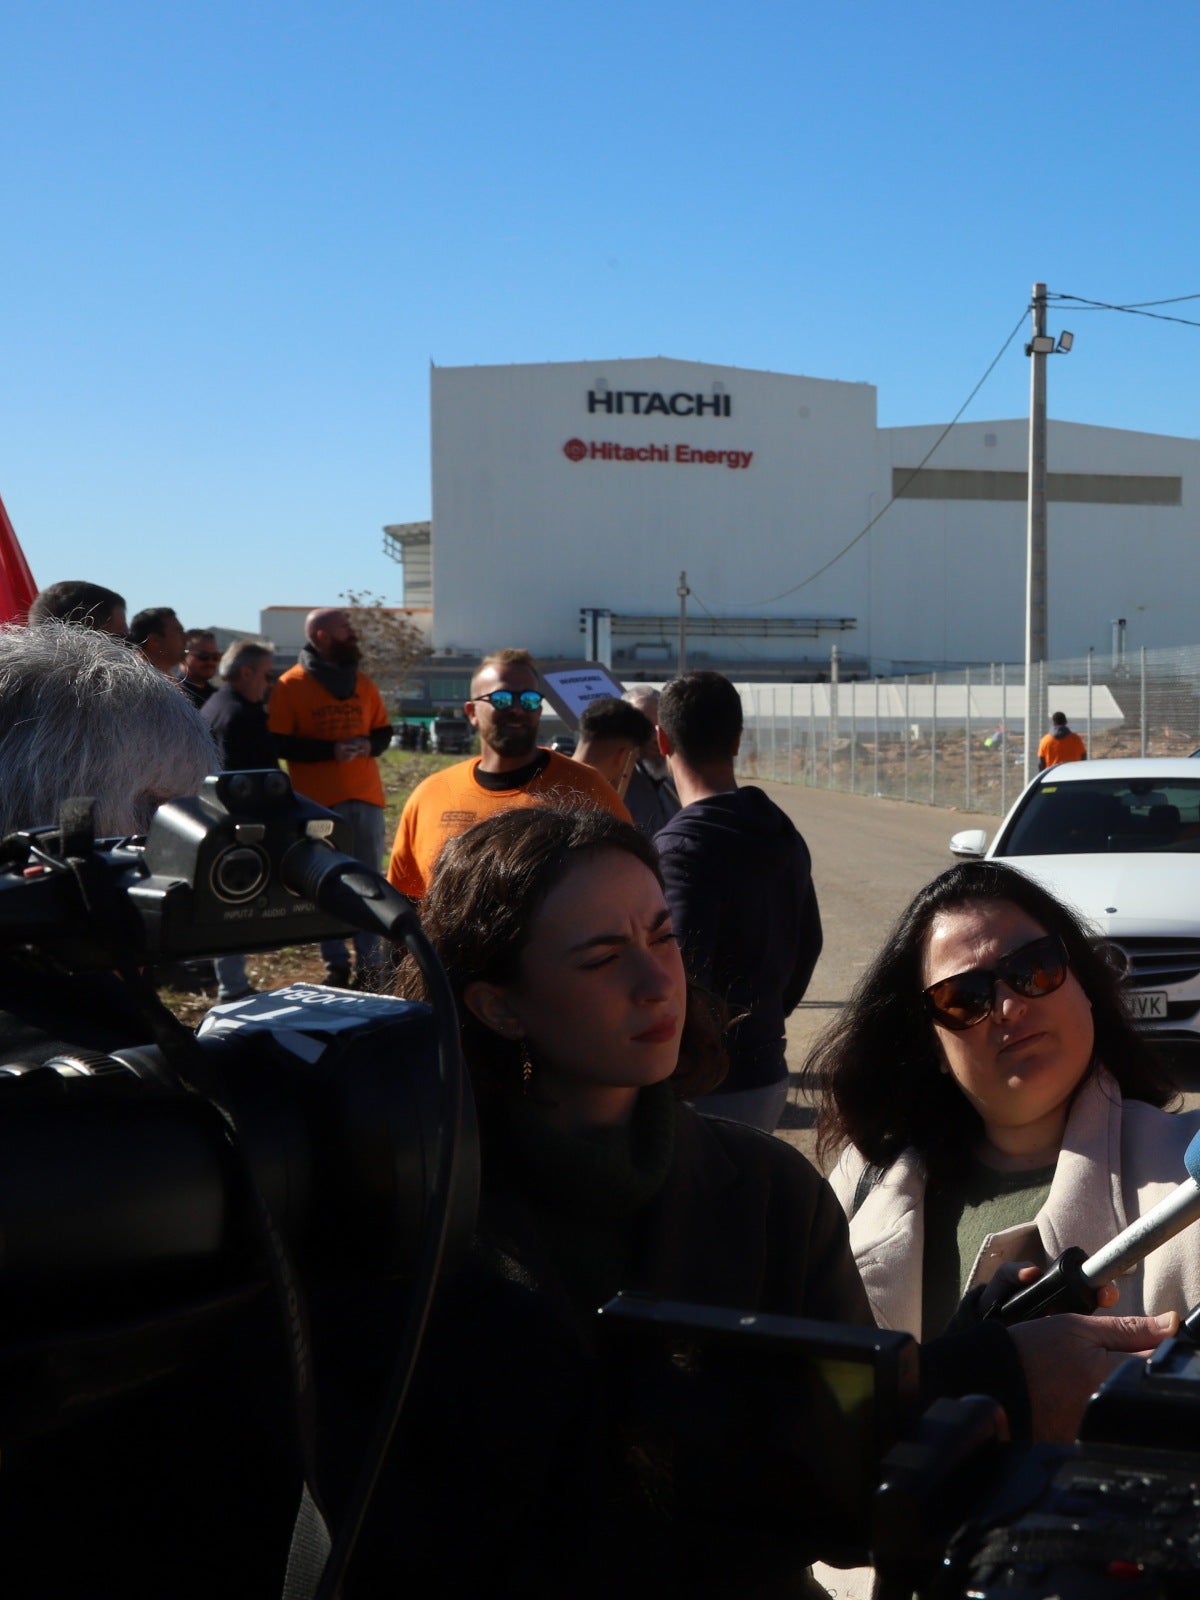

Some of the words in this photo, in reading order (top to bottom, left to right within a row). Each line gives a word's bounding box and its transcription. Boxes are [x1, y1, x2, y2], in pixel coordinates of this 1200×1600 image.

[587, 391, 731, 417] HITACHI
[590, 441, 669, 463] Hitachi
[675, 444, 753, 469] Energy
